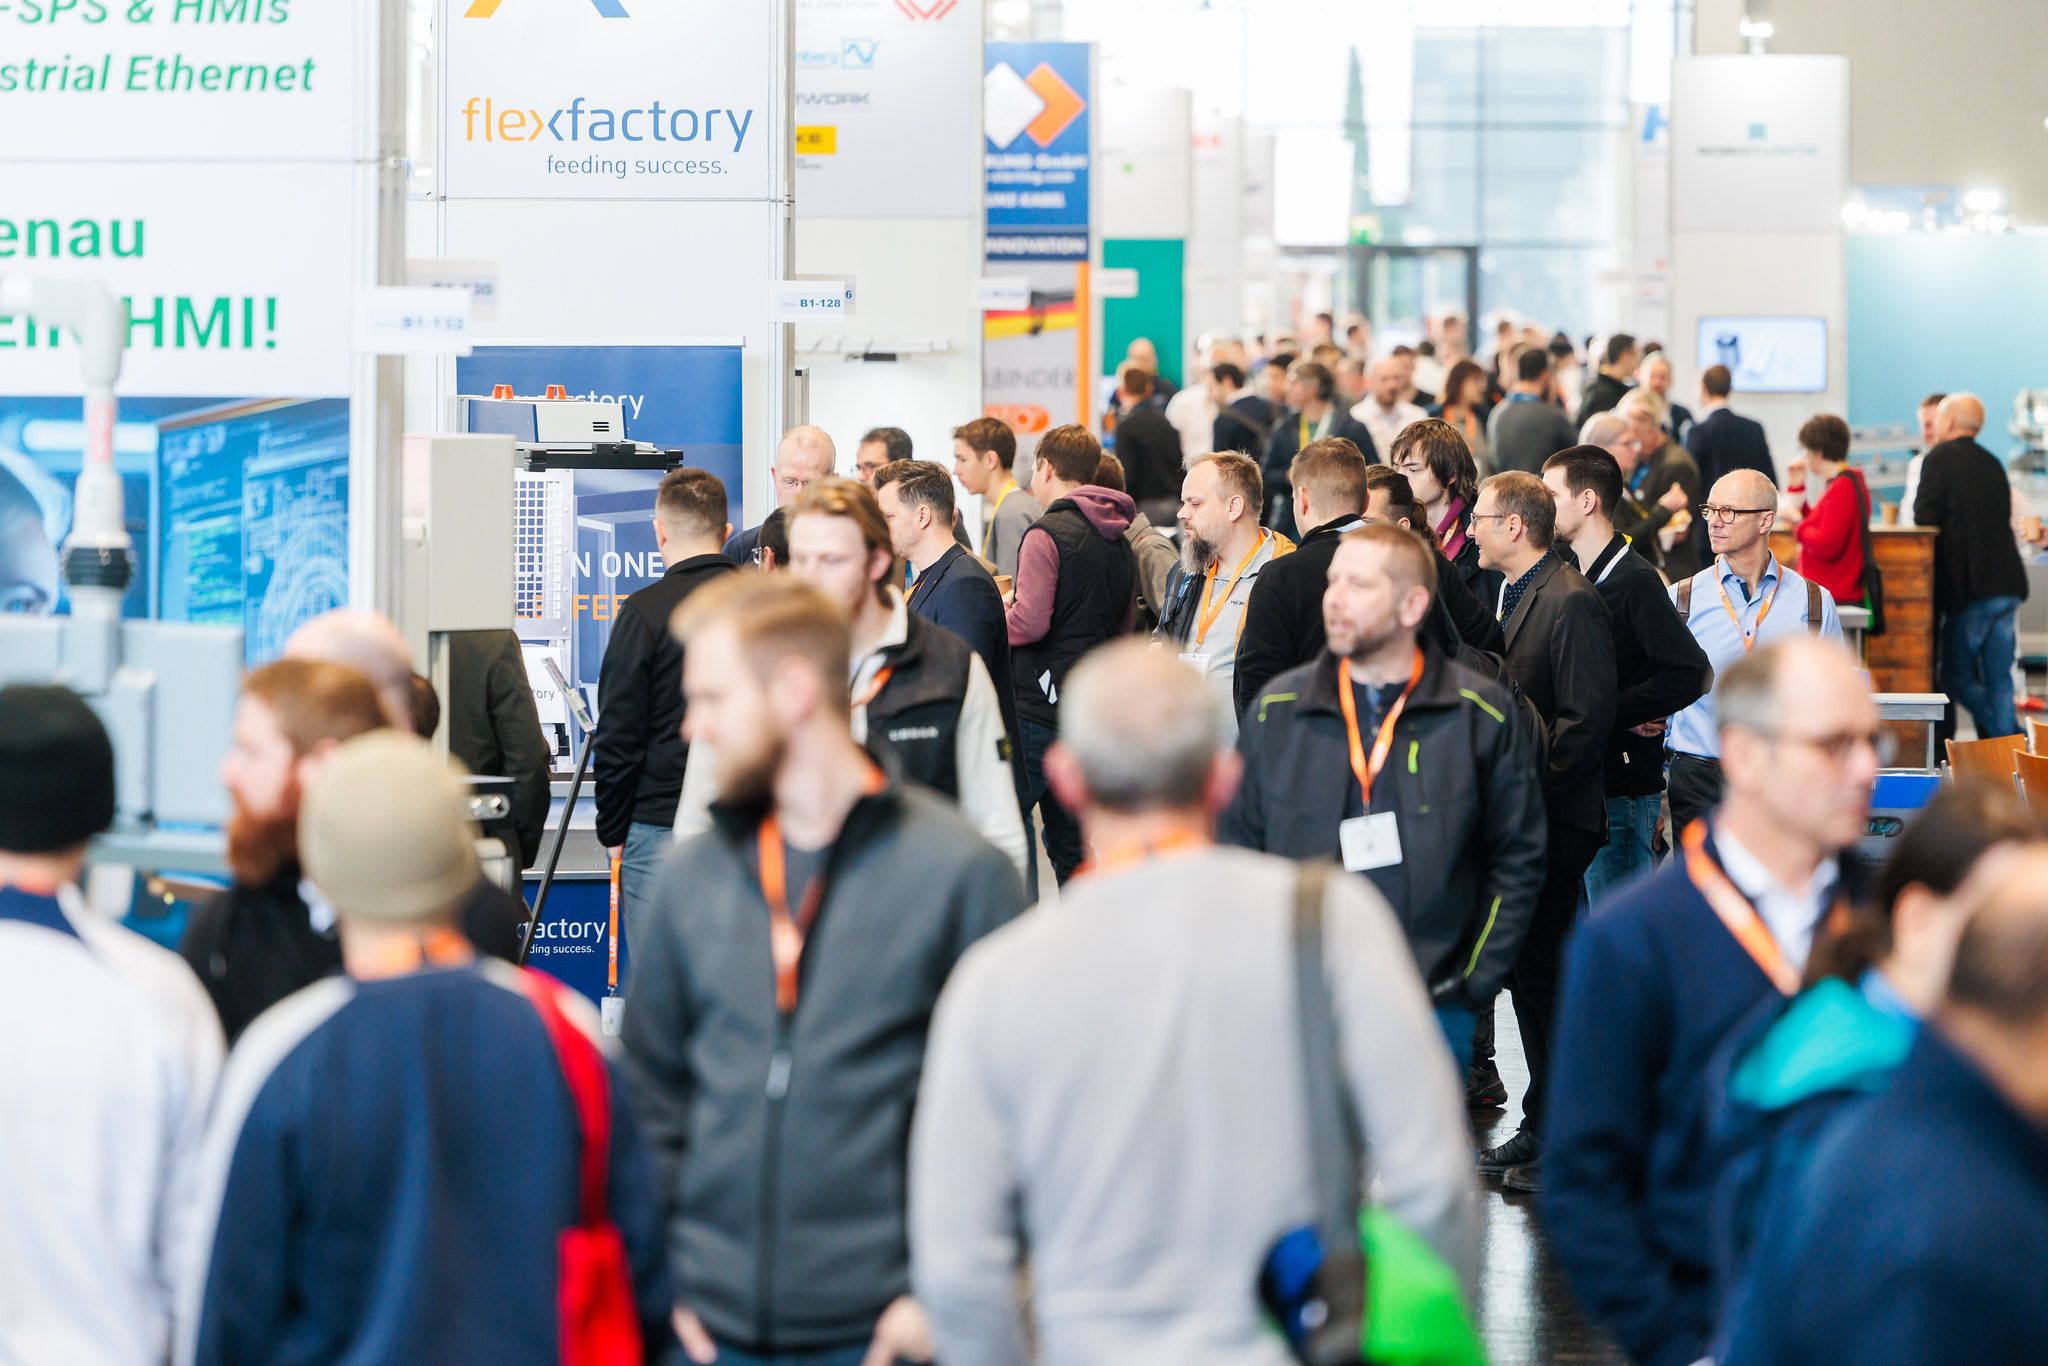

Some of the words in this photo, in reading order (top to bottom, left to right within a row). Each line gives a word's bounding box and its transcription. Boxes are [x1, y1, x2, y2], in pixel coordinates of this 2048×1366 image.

[126, 0, 154, 23] &
[173, 0, 290, 23] HMIs
[0, 54, 111, 91] strial
[125, 54, 316, 91] Ethernet
[462, 97, 754, 153] flexfactory
[547, 155, 626, 179] feeding
[634, 157, 729, 175] success.
[800, 298, 842, 308] B1-128
[121, 297, 278, 349] HMI!
[601, 551, 667, 578] ONE
[553, 945, 595, 954] success.
